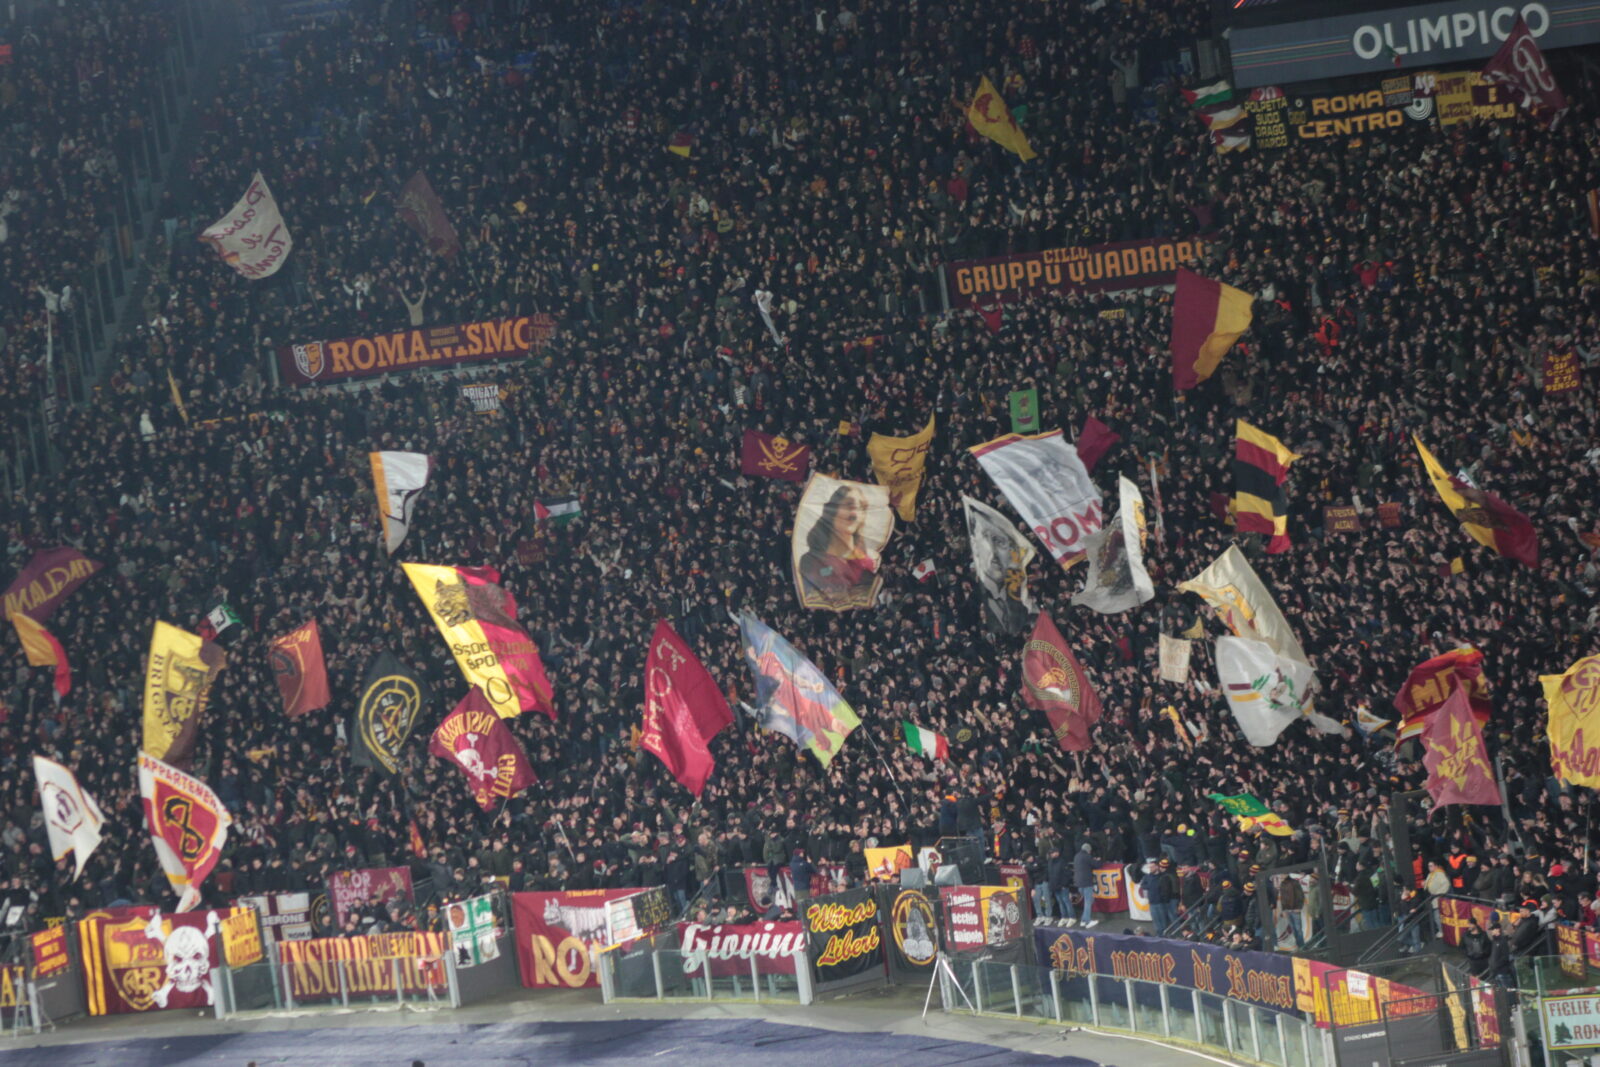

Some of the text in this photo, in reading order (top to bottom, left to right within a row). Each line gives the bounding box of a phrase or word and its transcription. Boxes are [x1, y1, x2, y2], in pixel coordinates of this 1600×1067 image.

[1353, 3, 1549, 60] OLIMPICO
[1312, 89, 1384, 116] ROMA
[1298, 109, 1404, 139] CENTRO
[956, 259, 1062, 295] GRUPPO
[1034, 498, 1103, 553] ROM
[530, 932, 603, 989] RO
[816, 926, 880, 967] Liberi
[1048, 932, 1096, 982] Nel
[1110, 950, 1177, 985] nome
[1191, 948, 1215, 993] di
[1224, 953, 1294, 1009] Roma
[1548, 1000, 1592, 1017] FIGLIE
